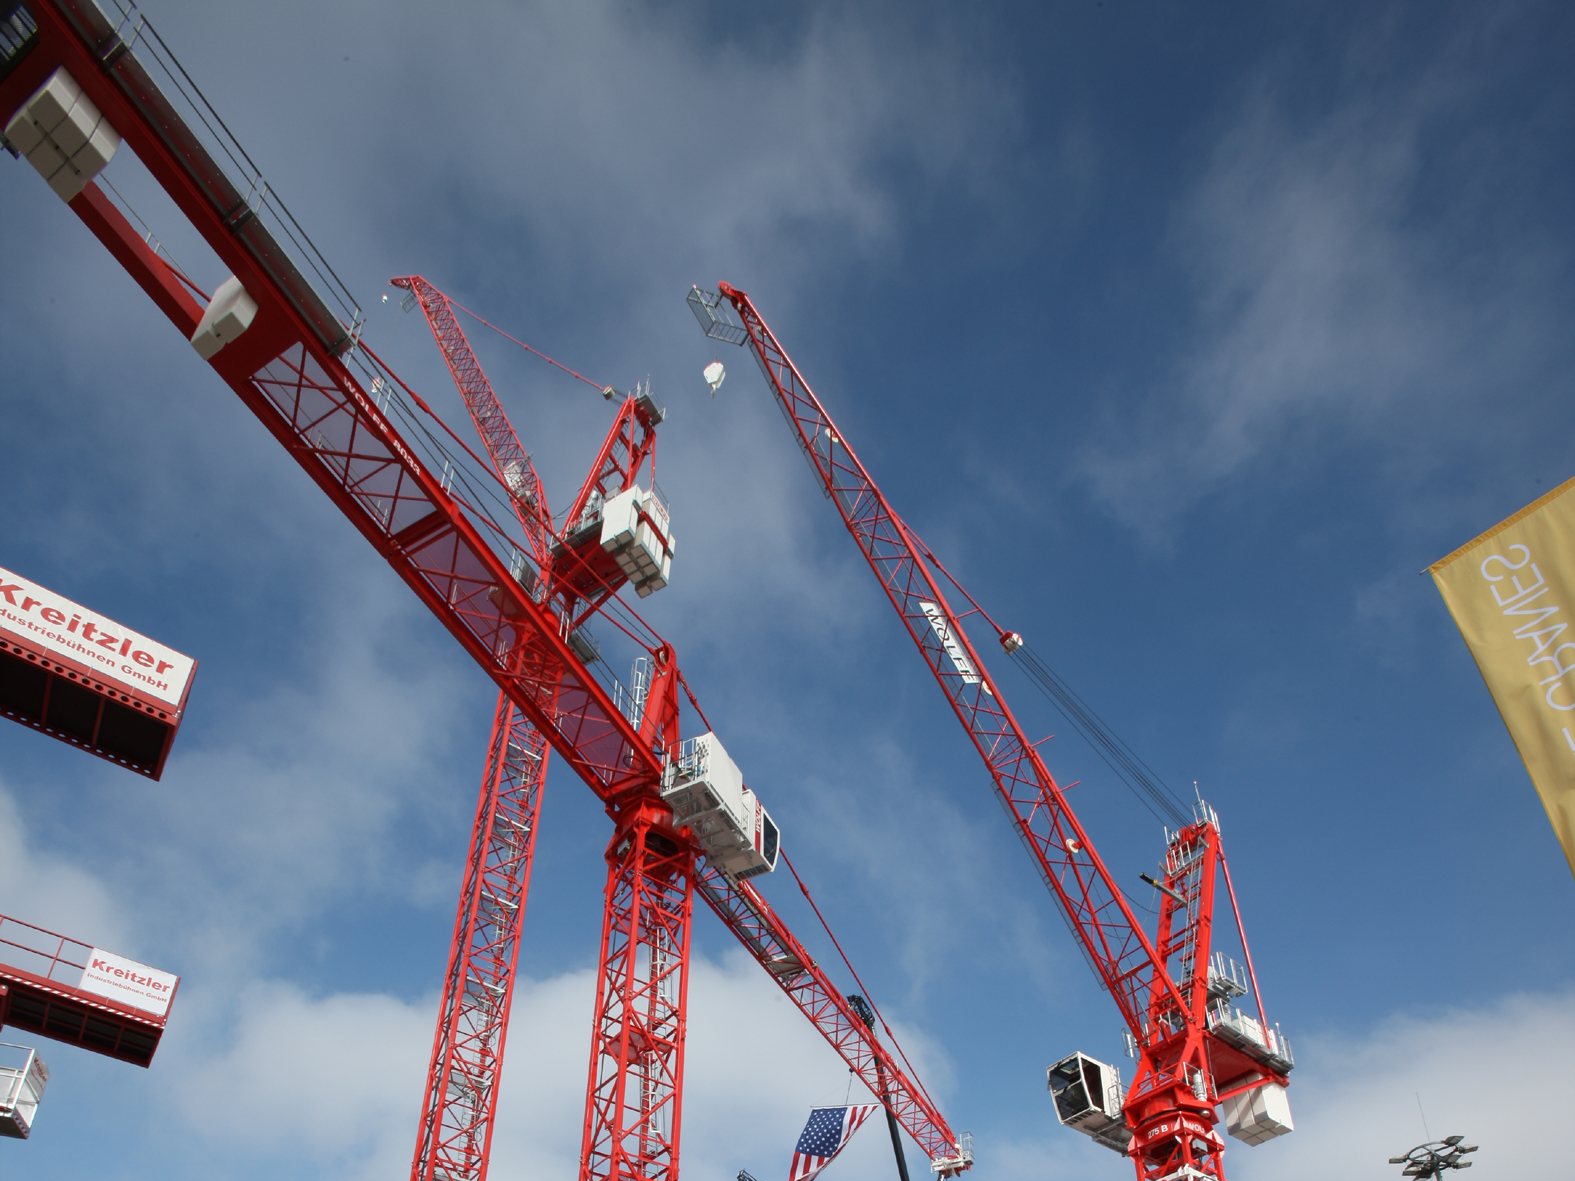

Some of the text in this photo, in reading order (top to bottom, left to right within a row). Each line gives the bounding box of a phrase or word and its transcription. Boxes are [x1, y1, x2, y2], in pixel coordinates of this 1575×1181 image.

[0, 578, 174, 675] Kreitzler
[925, 608, 975, 682] WOLFF
[121, 665, 168, 691] GmbH
[92, 958, 171, 992] Kreitzler
[146, 992, 168, 1003] GmbH
[1148, 1124, 1168, 1139] 275 B
